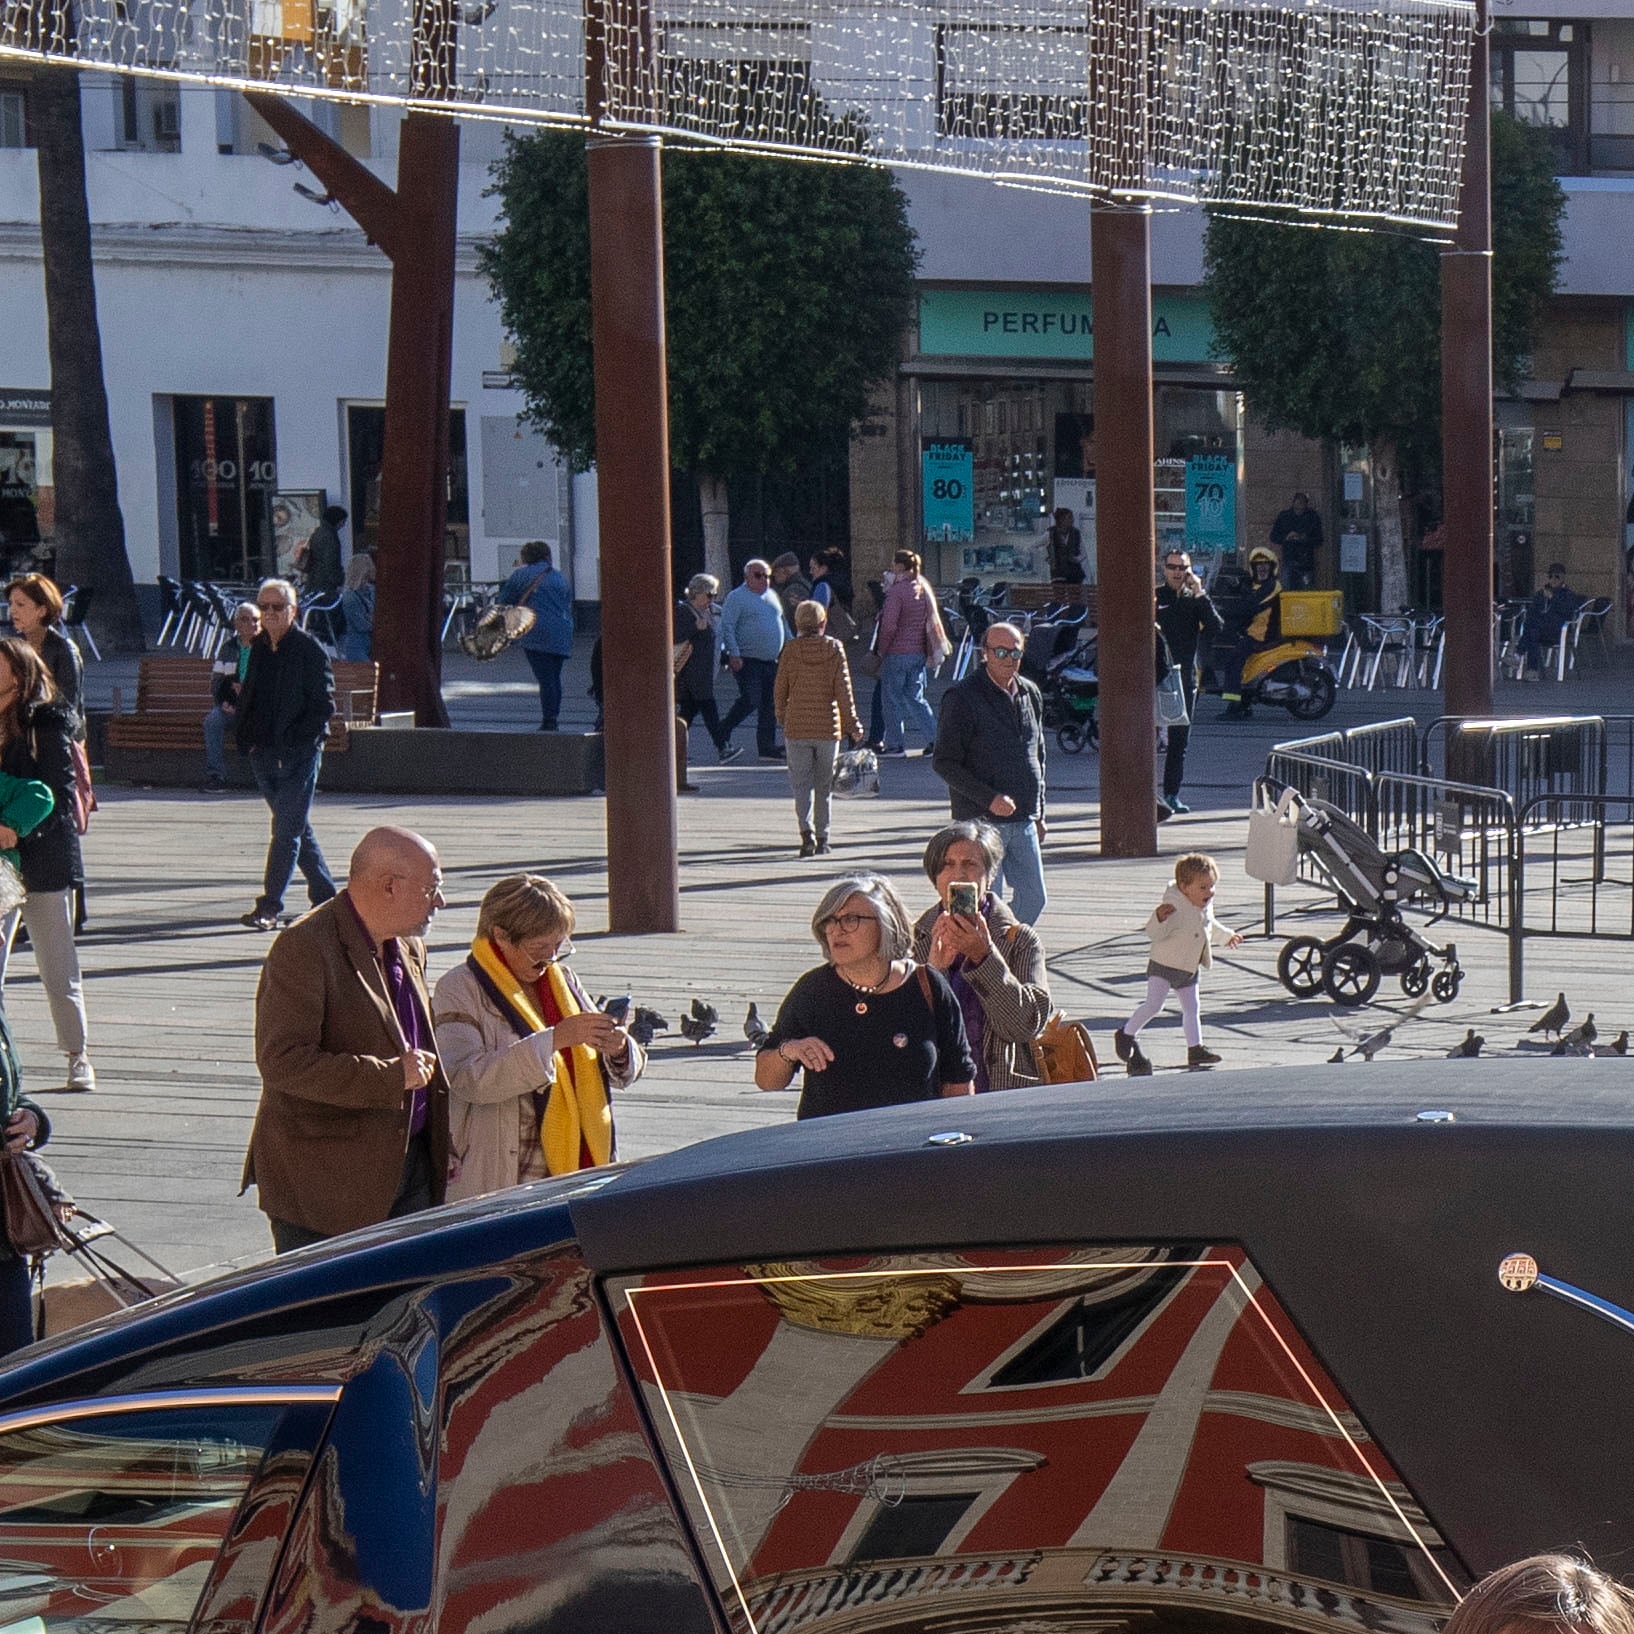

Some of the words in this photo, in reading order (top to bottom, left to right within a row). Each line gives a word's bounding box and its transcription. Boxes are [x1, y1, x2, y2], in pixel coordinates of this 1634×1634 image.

[983, 311, 1172, 337] PERFUMA
[928, 452, 966, 461] FRIDAY
[1191, 463, 1228, 472] FRIDAY
